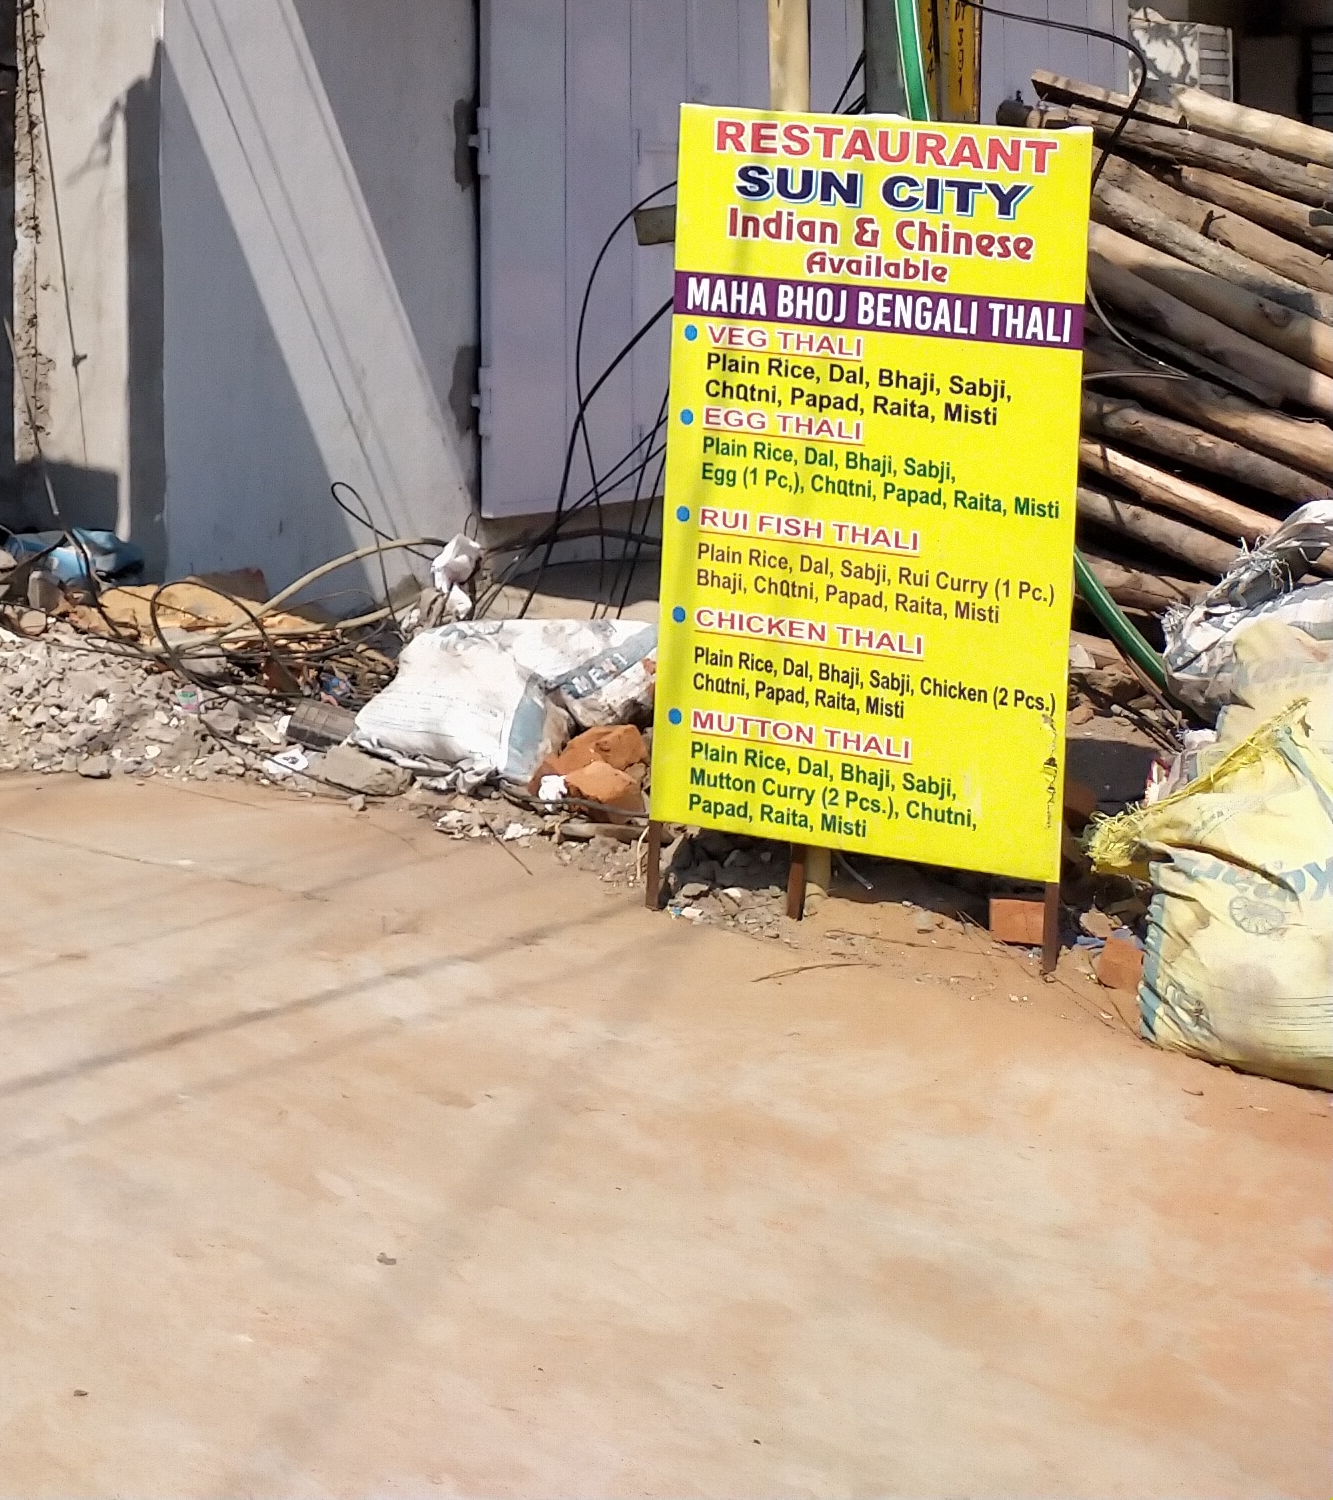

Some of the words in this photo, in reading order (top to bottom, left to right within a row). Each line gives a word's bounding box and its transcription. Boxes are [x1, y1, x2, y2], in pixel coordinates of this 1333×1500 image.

[717, 121, 1057, 173] RESTAURANT
[736, 166, 863, 208] SUN
[882, 176, 1034, 220] CITY
[729, 208, 838, 244] Indian
[854, 217, 879, 248] &
[896, 221, 1033, 260] Chinese
[807, 252, 947, 282] Available
[687, 277, 766, 316] MAHA
[778, 285, 846, 322] BHOJ
[858, 292, 977, 334] BENGALI
[989, 303, 1071, 342] THALI
[709, 326, 766, 347] VEG
[778, 332, 861, 356] THALI
[707, 352, 759, 374] Plain
[768, 358, 820, 384] Rice,
[829, 364, 869, 389] Dal,
[879, 368, 940, 396] Bhaji,
[949, 375, 1011, 403] Sabji,
[705, 408, 765, 429] EGG
[777, 415, 860, 439] THALI
[791, 387, 864, 416] Papad,
[873, 395, 935, 423] Raita,
[944, 402, 997, 425] Misti
[703, 436, 746, 457] Plain
[754, 442, 797, 466] Rice,
[805, 447, 838, 471] Dal,
[846, 451, 897, 477] Bhaji,
[904, 458, 955, 484] Sabji,
[702, 462, 736, 487] Egg
[743, 467, 757, 489] (1
[766, 470, 804, 495] Pc,),
[884, 482, 946, 509] Papad,
[954, 490, 1006, 517] Raita,
[1015, 497, 1059, 519] Misti
[701, 509, 747, 530] RUI
[759, 516, 821, 538] FISH
[833, 524, 917, 550] THALI
[697, 569, 746, 594] Bhaji,
[826, 584, 887, 612] Papad,
[896, 593, 947, 620] Raita,
[955, 600, 999, 623] Misti
[698, 542, 741, 564] Plain
[749, 549, 792, 574] Rice,
[800, 555, 833, 579] Dal,
[841, 560, 891, 586] Sabji,
[899, 567, 929, 587] Rui
[936, 572, 988, 599] Curry
[995, 578, 1009, 601] (1
[1019, 581, 1054, 607] Pc.)
[697, 610, 825, 641] CHICKEN
[836, 627, 921, 654] THALI
[695, 646, 733, 668] Plain
[739, 652, 777, 677] Rice,
[783, 658, 813, 682] Dal,
[819, 662, 863, 689] Bhaji,
[869, 670, 914, 696] Sabji,
[921, 677, 987, 703] Chicken
[993, 686, 1008, 710] (2
[1014, 689, 1055, 717] Pcs.)
[755, 680, 809, 708] Papad,
[815, 689, 859, 715] Raita,
[866, 696, 904, 719] Misti
[692, 710, 815, 745] MUTTON
[824, 728, 912, 761] THALI
[691, 741, 737, 764] Plain
[744, 748, 790, 775] Rice,
[798, 756, 833, 782] Dal,
[841, 763, 895, 791] Bhaji,
[902, 773, 956, 801] Sabji,
[689, 794, 752, 823] Papad,
[761, 804, 813, 832] Raita,
[821, 813, 866, 837] Misti
[690, 767, 755, 793] Mutton
[763, 778, 815, 806] Curry
[822, 786, 839, 810] (2
[846, 790, 898, 819] Pcs.),
[907, 793, 976, 831] Chutni,
